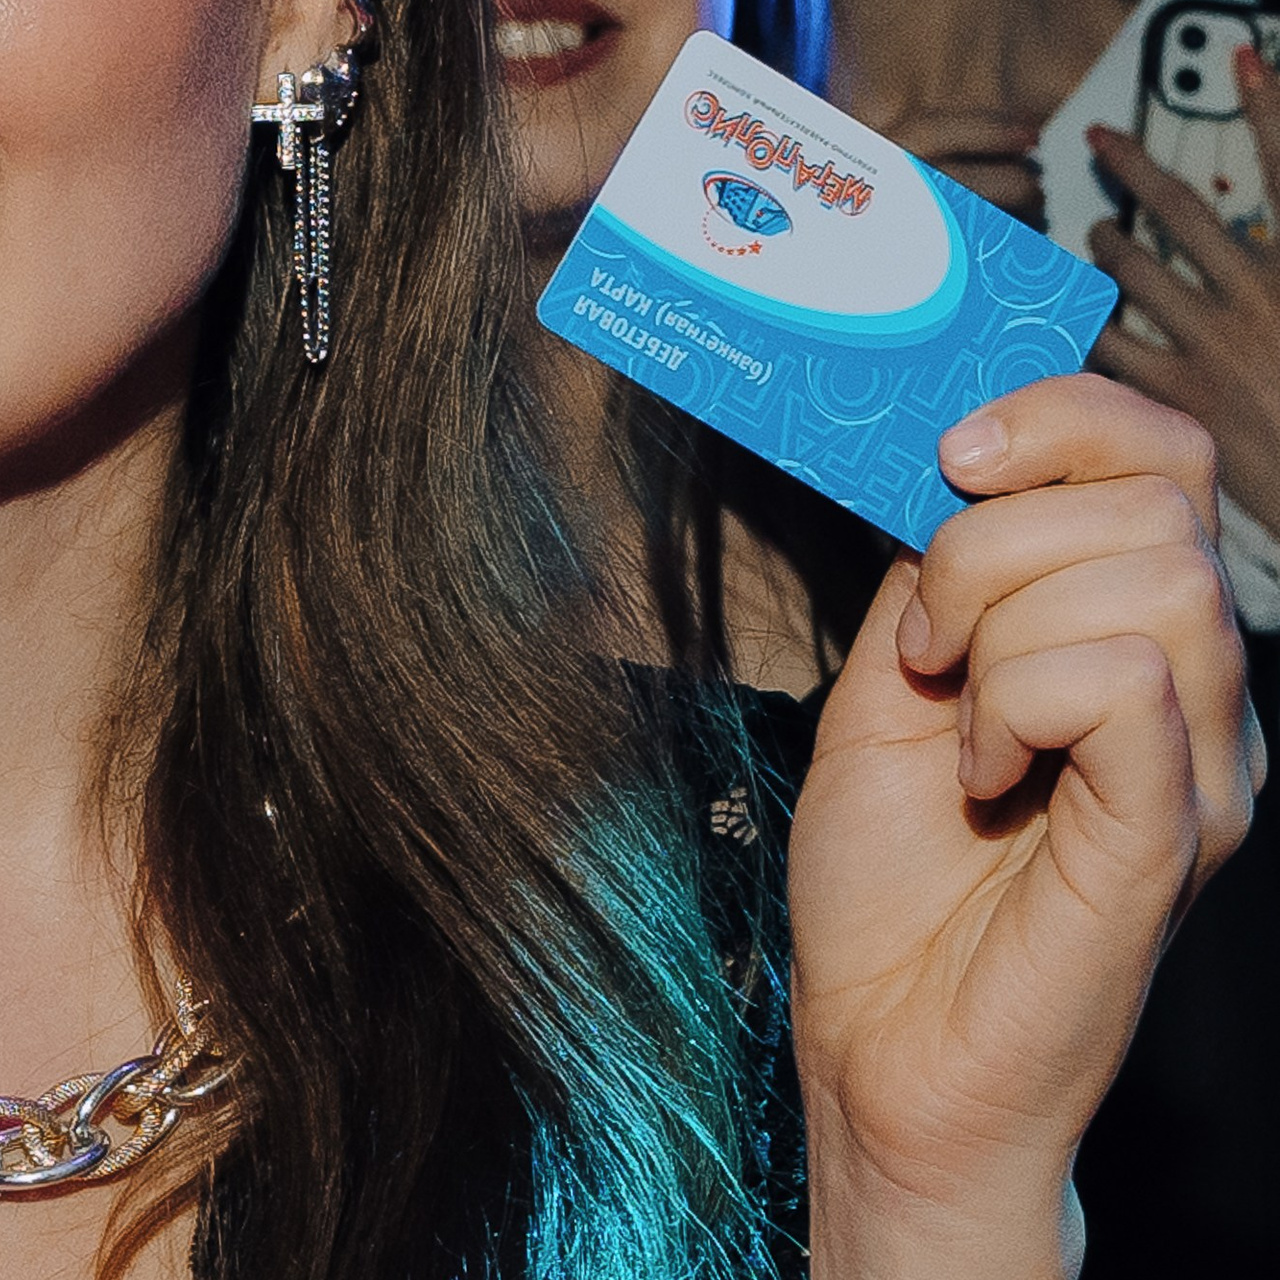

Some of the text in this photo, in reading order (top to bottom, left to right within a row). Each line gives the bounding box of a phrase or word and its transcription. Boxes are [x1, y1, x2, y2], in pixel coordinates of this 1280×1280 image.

[684, 90, 874, 216] МЕГАПОЛИС
[572, 294, 690, 371] ДЕБЕТОВАЯ
[590, 266, 773, 386] (банкетная) КАРТА
